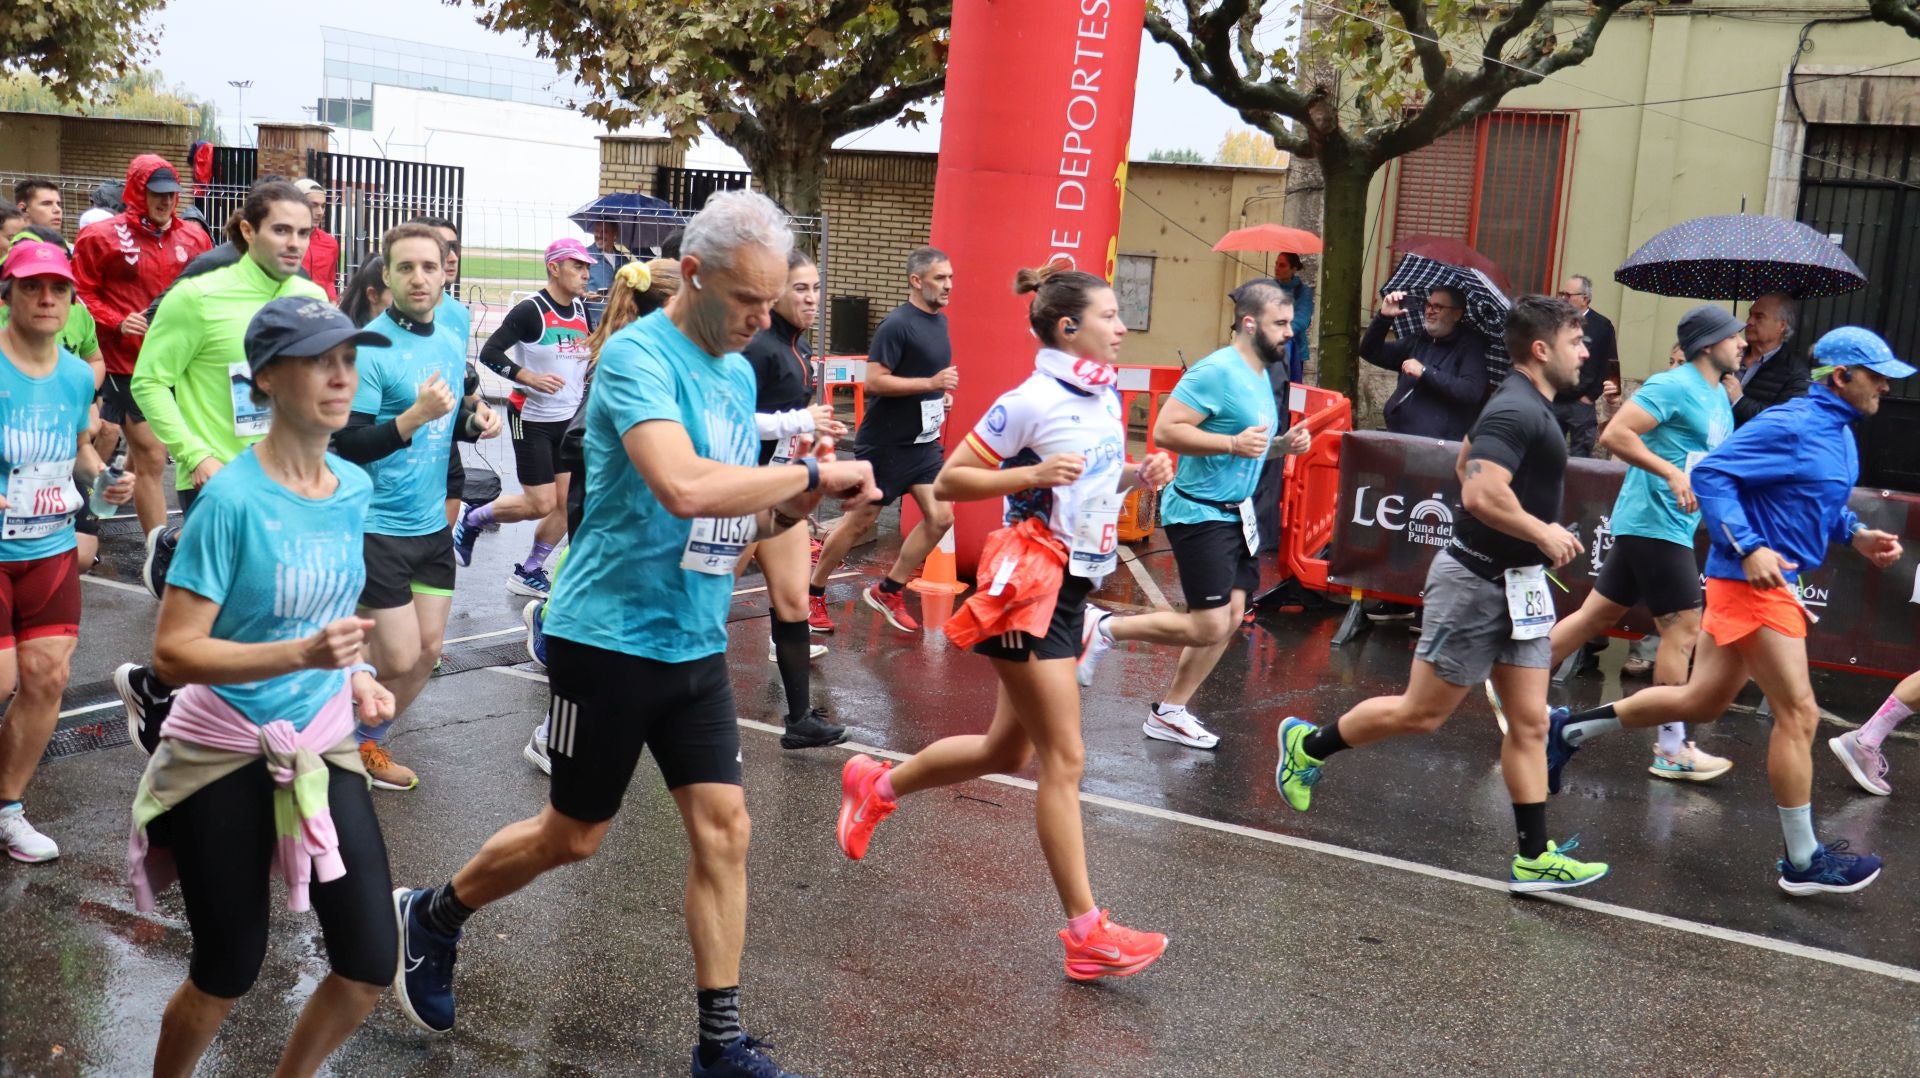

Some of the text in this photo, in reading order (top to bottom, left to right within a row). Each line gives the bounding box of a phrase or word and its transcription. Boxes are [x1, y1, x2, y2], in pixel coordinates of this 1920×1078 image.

[1055, 0, 1111, 211] DEPORTES
[33, 486, 67, 516] 1119
[1099, 523, 1115, 553] 6
[1408, 520, 1453, 537] Cuna del
